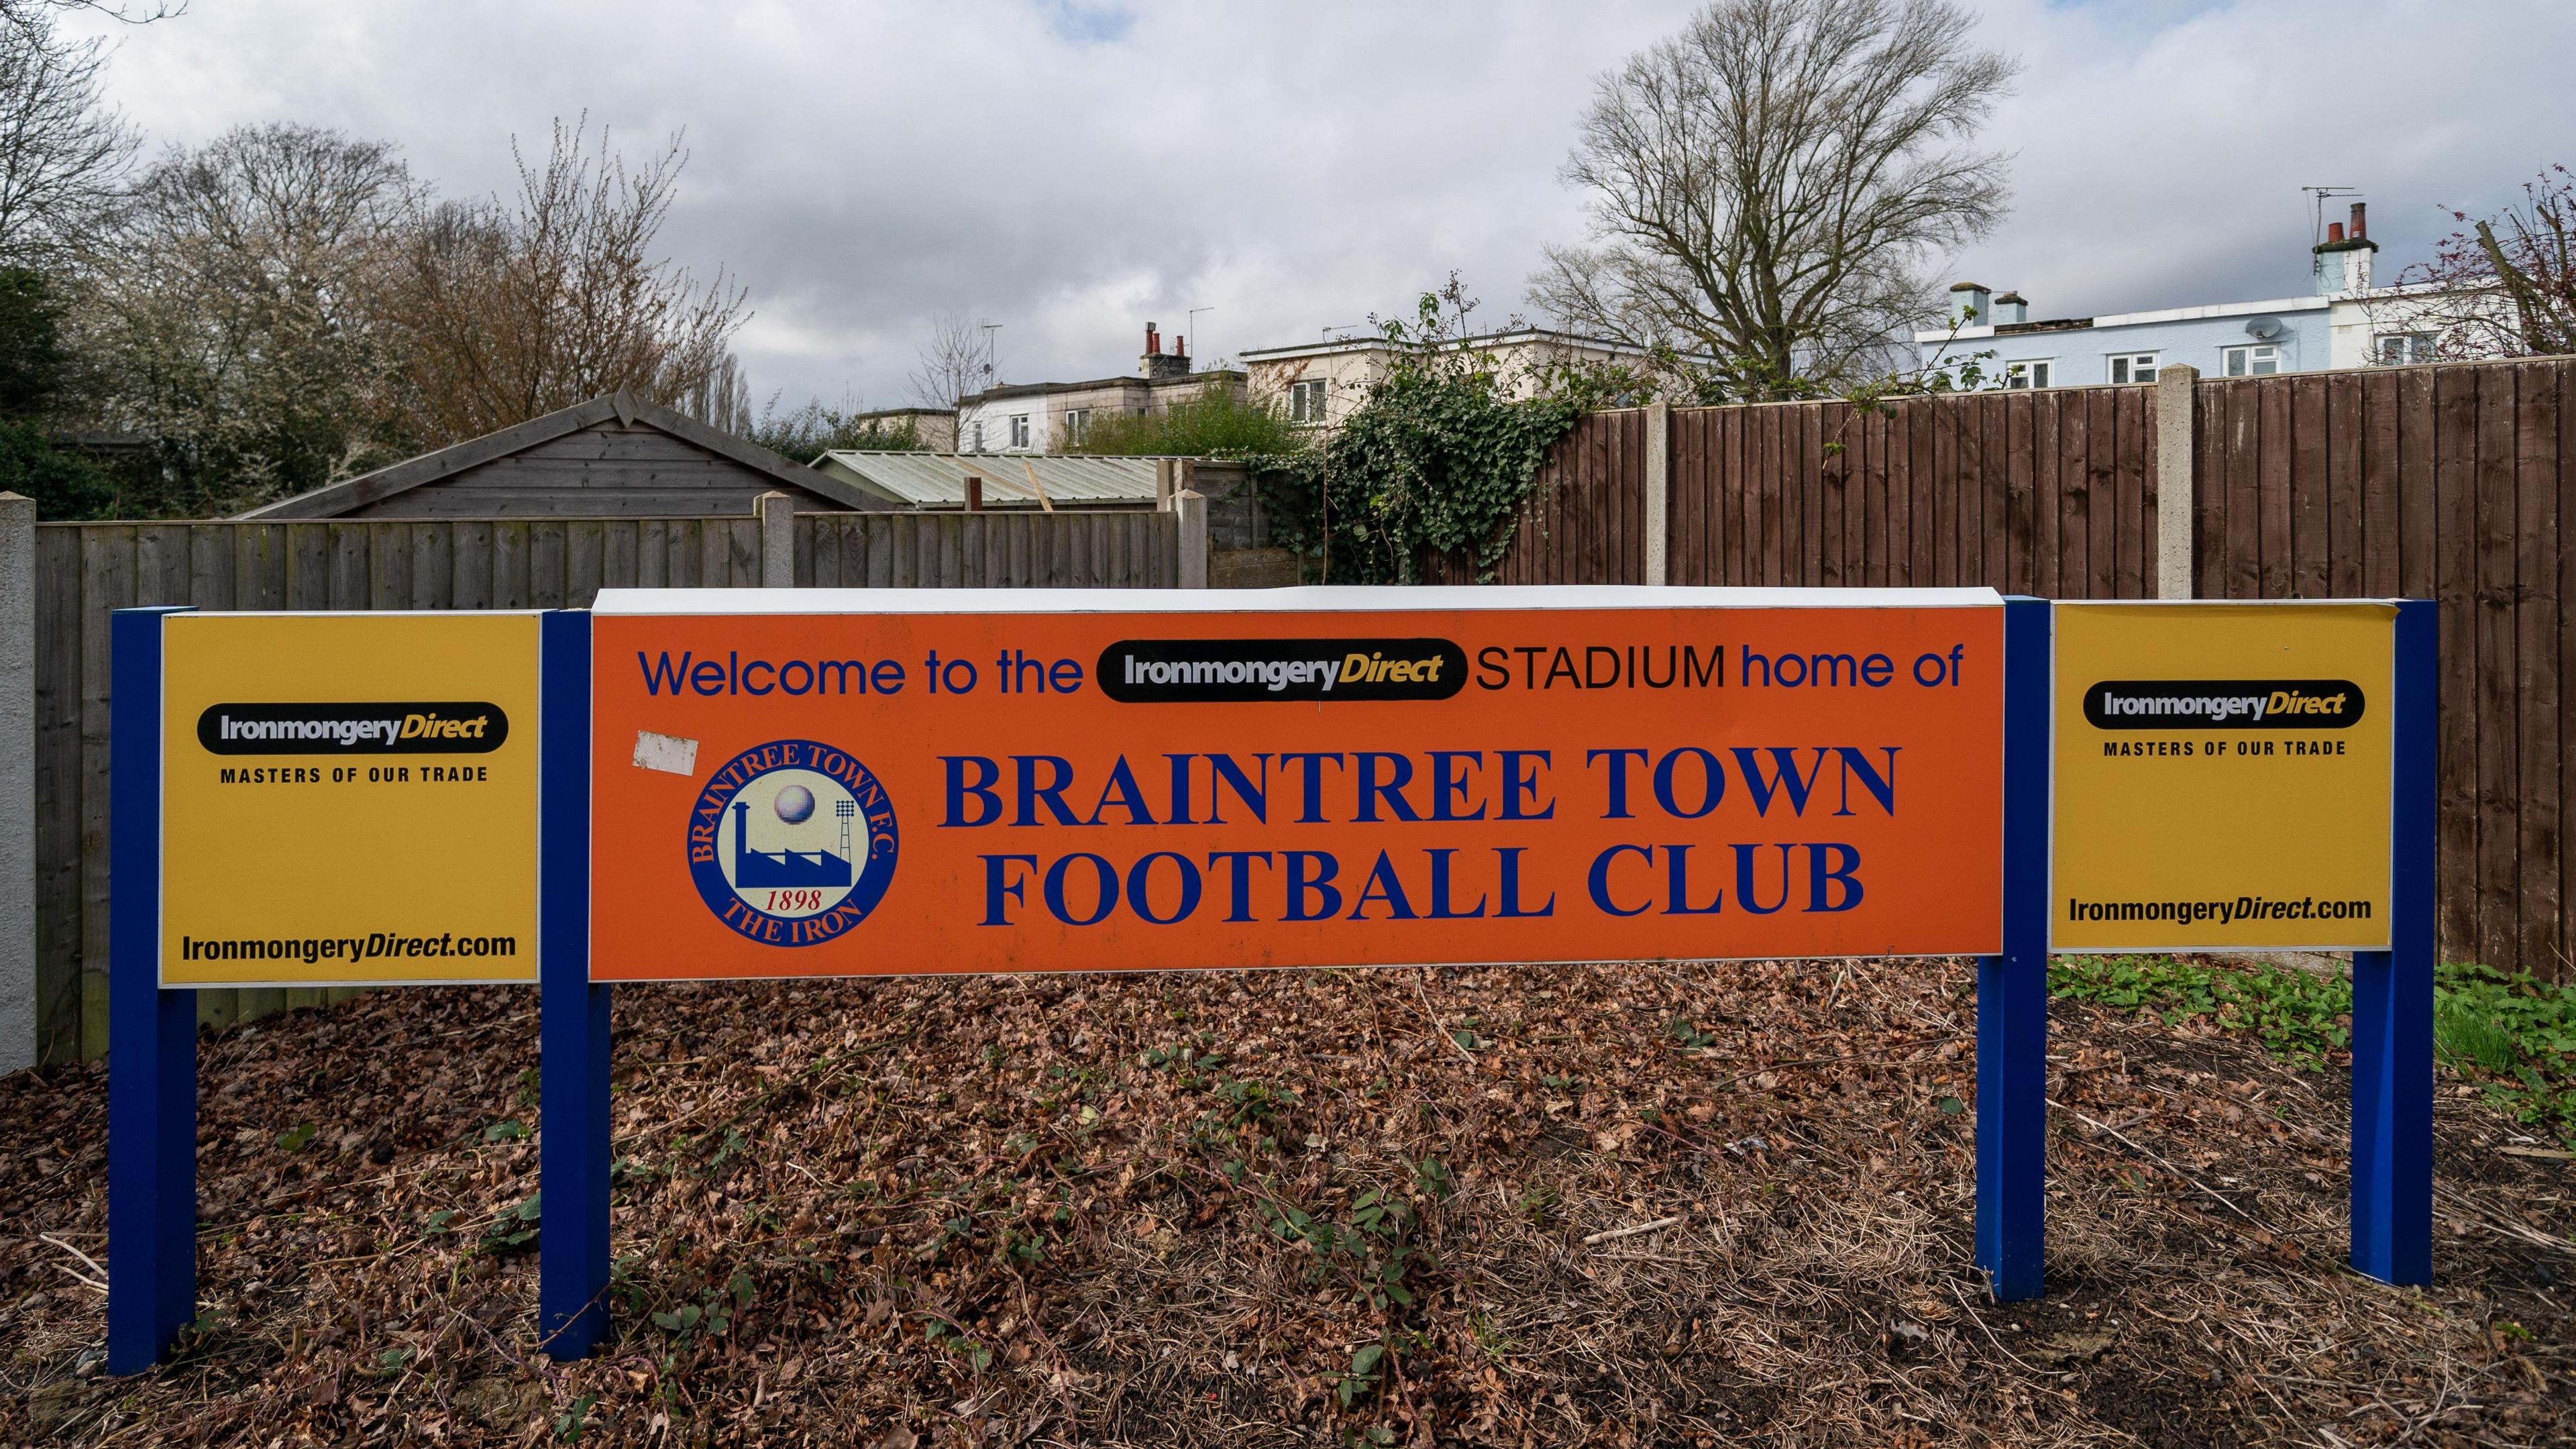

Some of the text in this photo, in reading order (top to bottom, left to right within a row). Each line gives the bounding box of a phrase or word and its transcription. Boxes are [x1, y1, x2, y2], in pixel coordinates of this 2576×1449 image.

[639, 643, 1964, 696] Welcome to the IronmongeryDirect STADIUM home of
[2104, 690, 2346, 720] IronmongeryDirect
[221, 712, 488, 745] IronmongeryDirect
[2104, 741, 2345, 757] MASTERS OF OUR TRADE
[220, 766, 487, 784] MASTERS OF OUR TRADE
[936, 747, 1902, 827] BRAINTREE TOWN
[692, 743, 895, 865] BRAINTREE TOWN F.C.
[764, 890, 822, 911] 1898
[977, 843, 1864, 926] FOOTBALL CLUB
[722, 897, 863, 943] THE IRON
[2070, 896, 2371, 925] IronmongeryDirect.com
[182, 932, 516, 964] IronmongeryDirect.com
